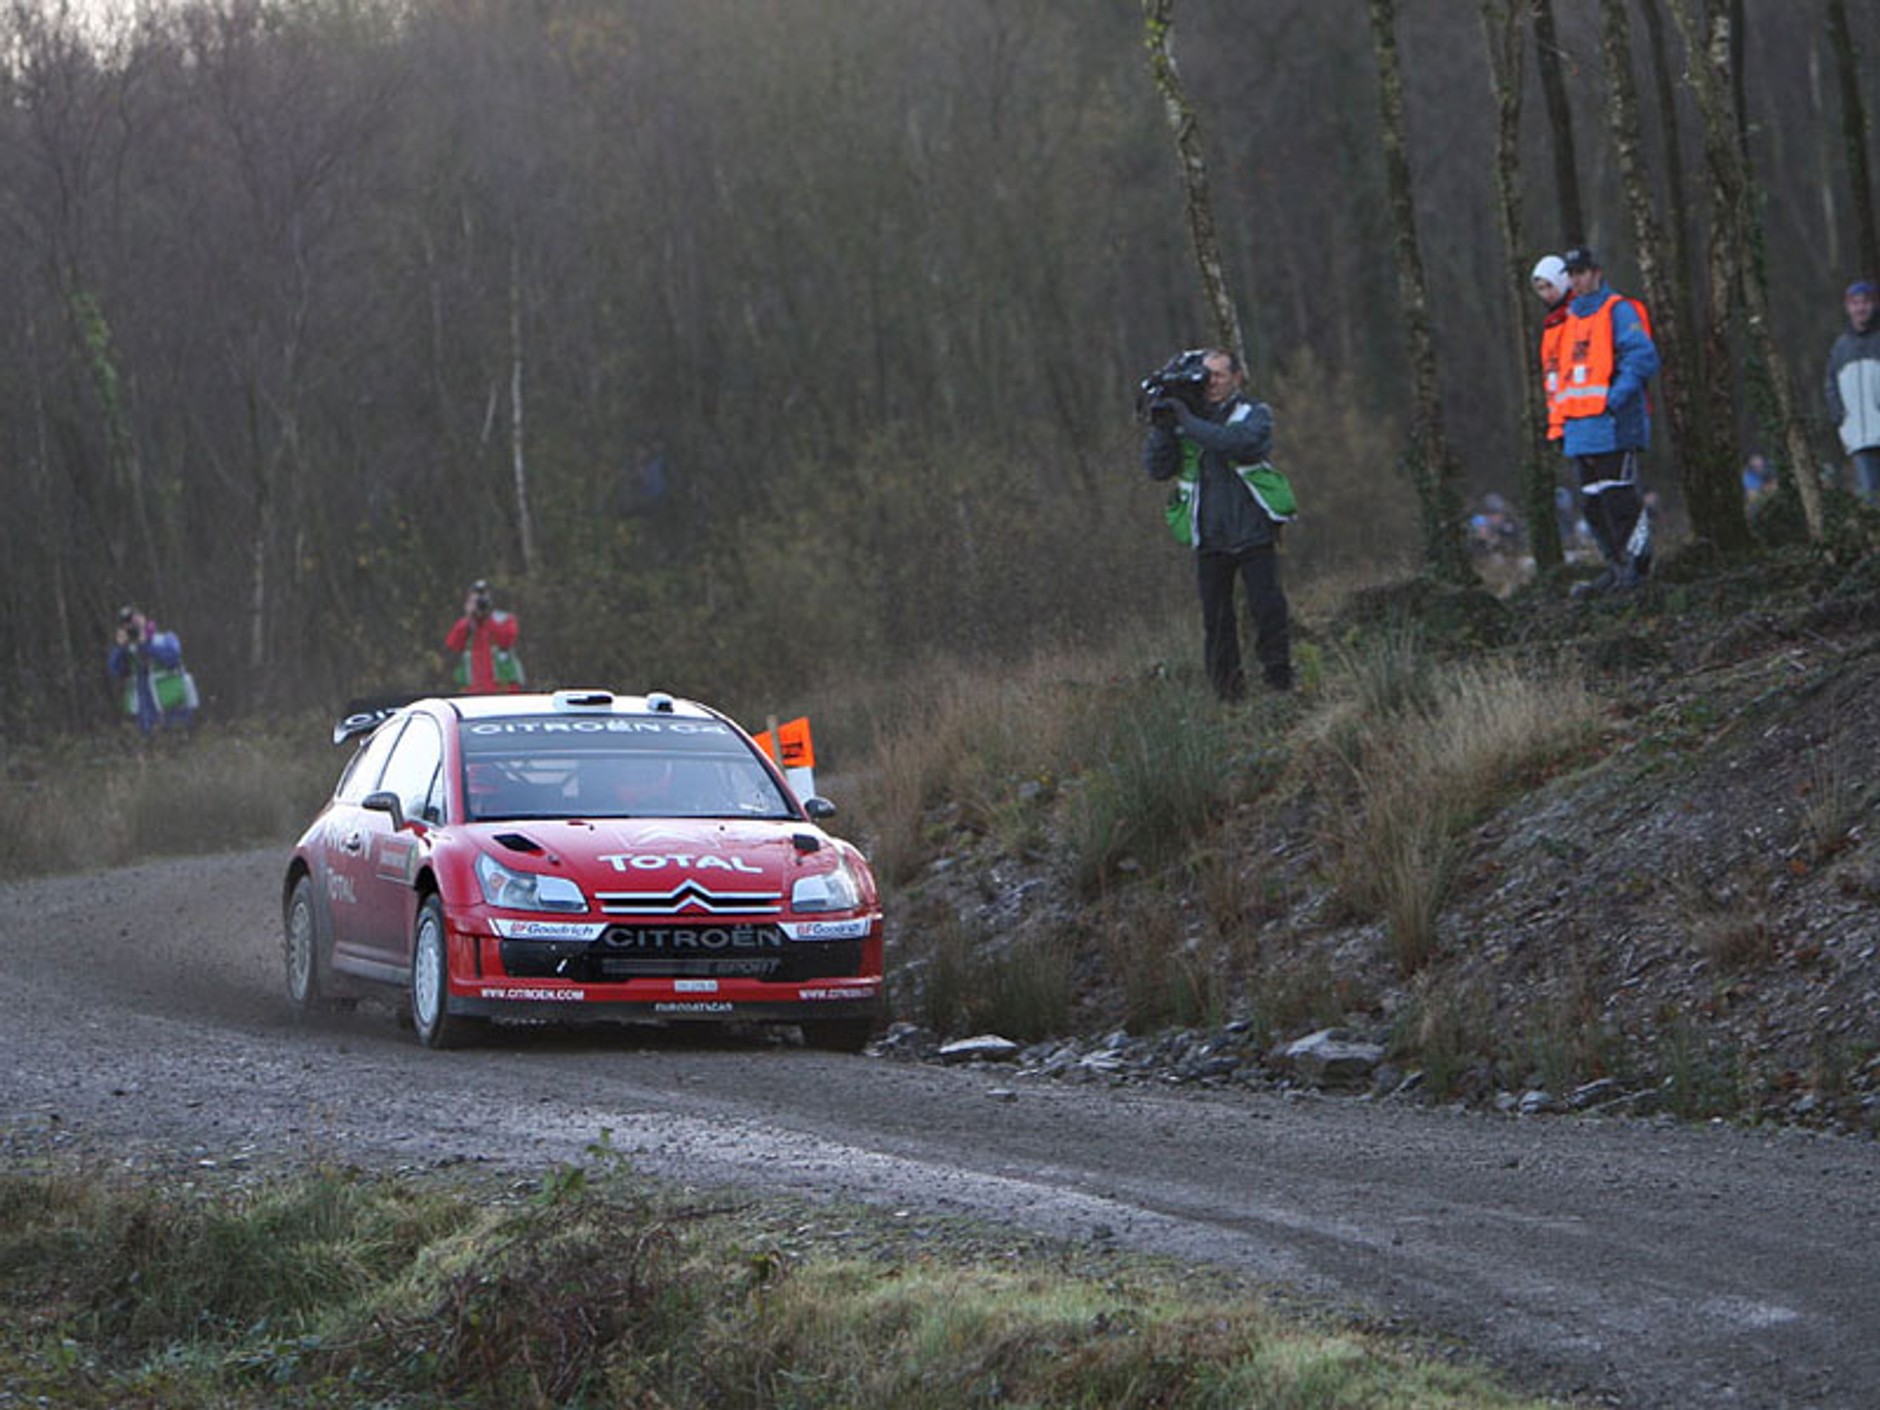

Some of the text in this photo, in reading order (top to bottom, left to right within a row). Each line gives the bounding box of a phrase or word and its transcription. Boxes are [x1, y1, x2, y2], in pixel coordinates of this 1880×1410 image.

[470, 719, 660, 735] CITROËN
[597, 853, 764, 873] TOTAL
[604, 923, 782, 948] CITROËN
